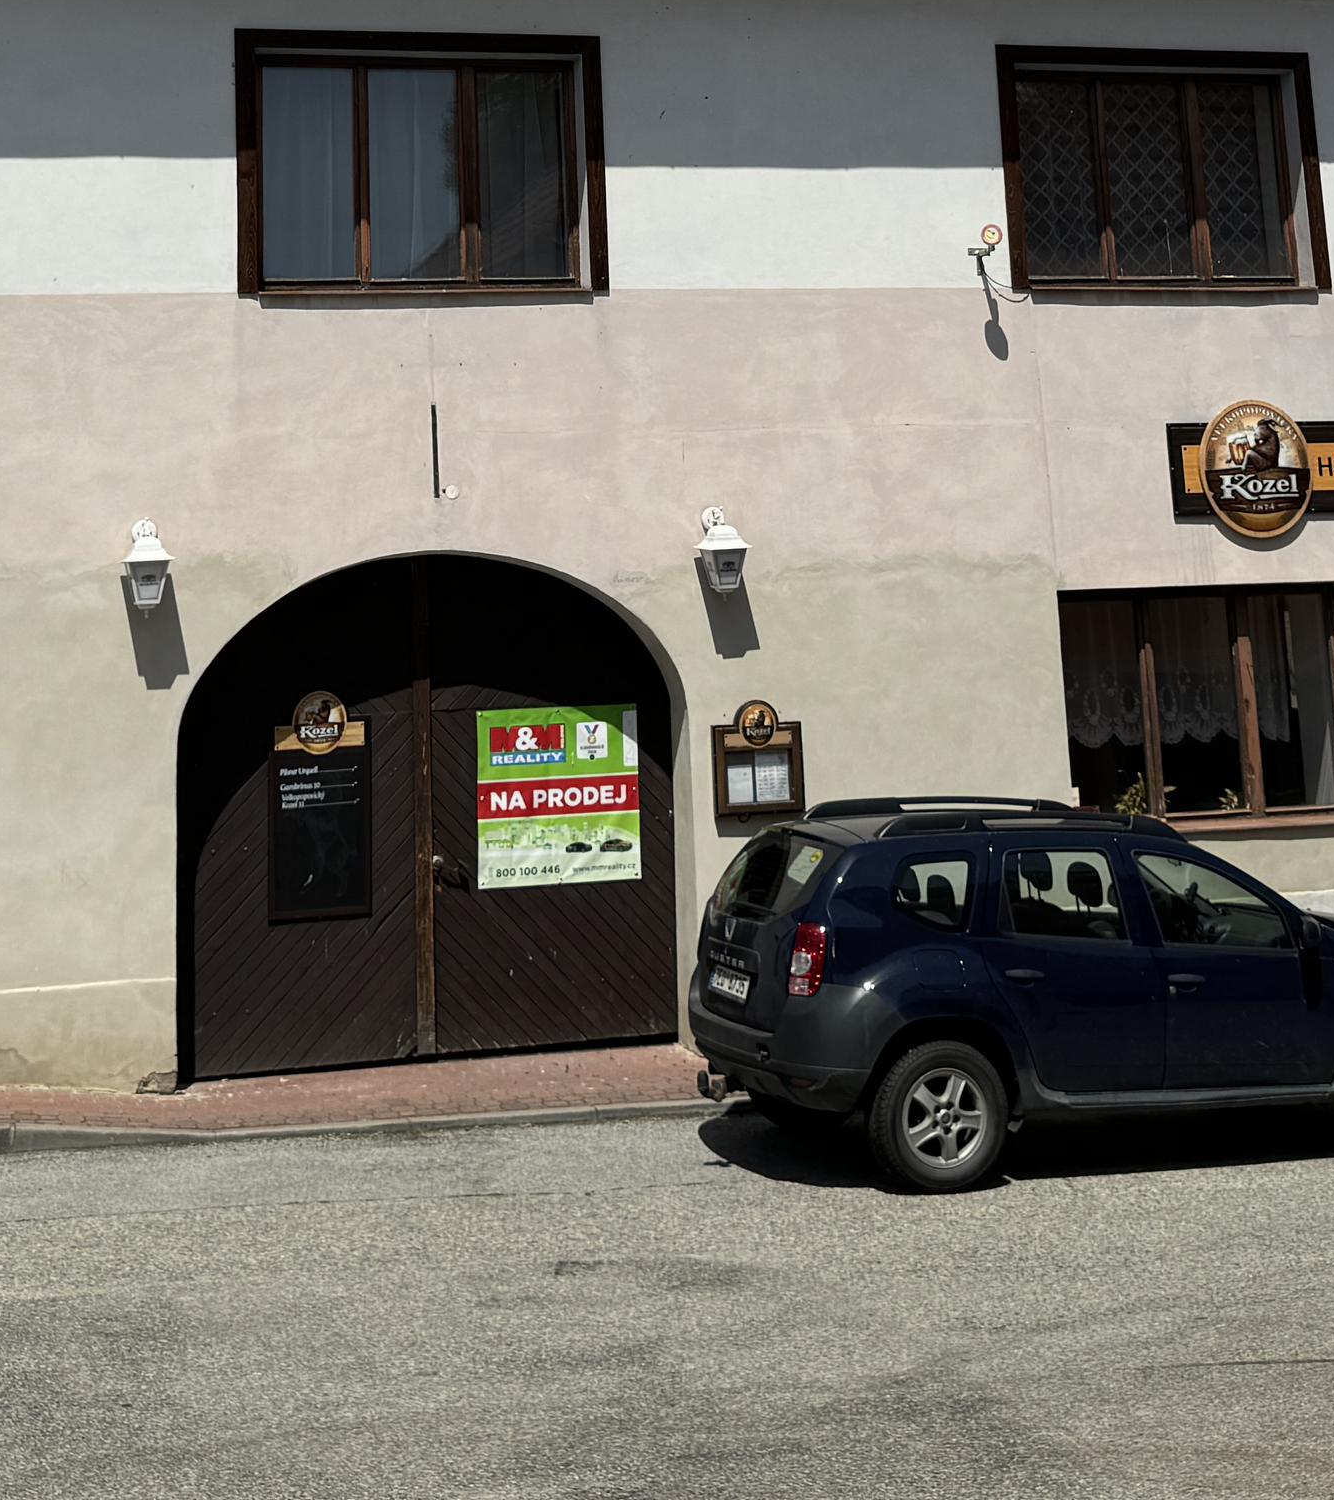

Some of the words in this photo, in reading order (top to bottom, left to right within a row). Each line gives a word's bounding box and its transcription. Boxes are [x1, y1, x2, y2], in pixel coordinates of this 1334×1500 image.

[1219, 473, 1300, 501] Kozel
[299, 724, 339, 739] Kozel
[490, 723, 560, 753] M&M
[491, 751, 564, 765] REALITY
[490, 791, 527, 811] NA
[532, 784, 628, 809] PRODEJ
[496, 868, 517, 878] 800
[519, 866, 538, 877] 100
[541, 864, 561, 875] 446
